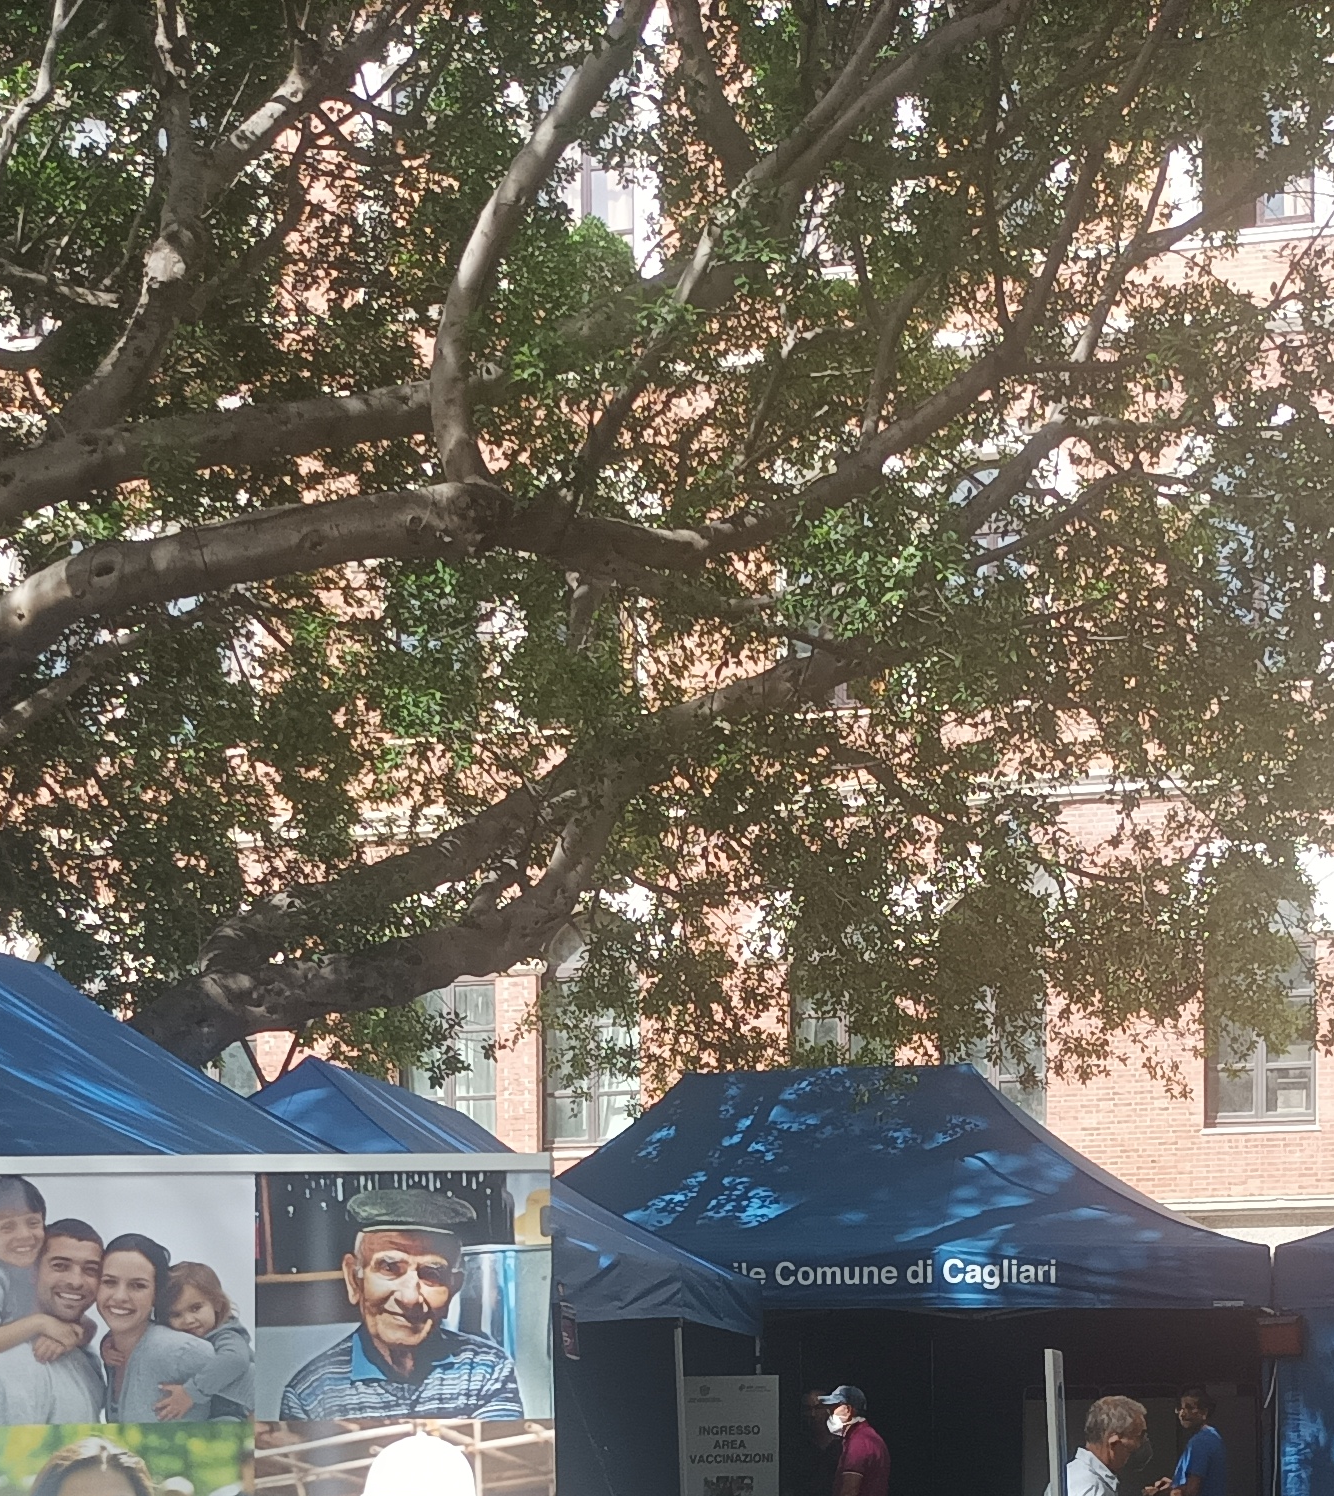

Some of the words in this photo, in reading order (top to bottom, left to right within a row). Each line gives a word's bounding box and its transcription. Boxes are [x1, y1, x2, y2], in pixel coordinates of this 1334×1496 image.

[775, 1261, 898, 1286] Comune
[906, 1260, 933, 1284] di
[942, 1258, 1056, 1290] Cagliari
[698, 1425, 761, 1436] INGRESSO
[713, 1440, 747, 1450] AREA
[689, 1453, 774, 1464] VACCINAZIONI
